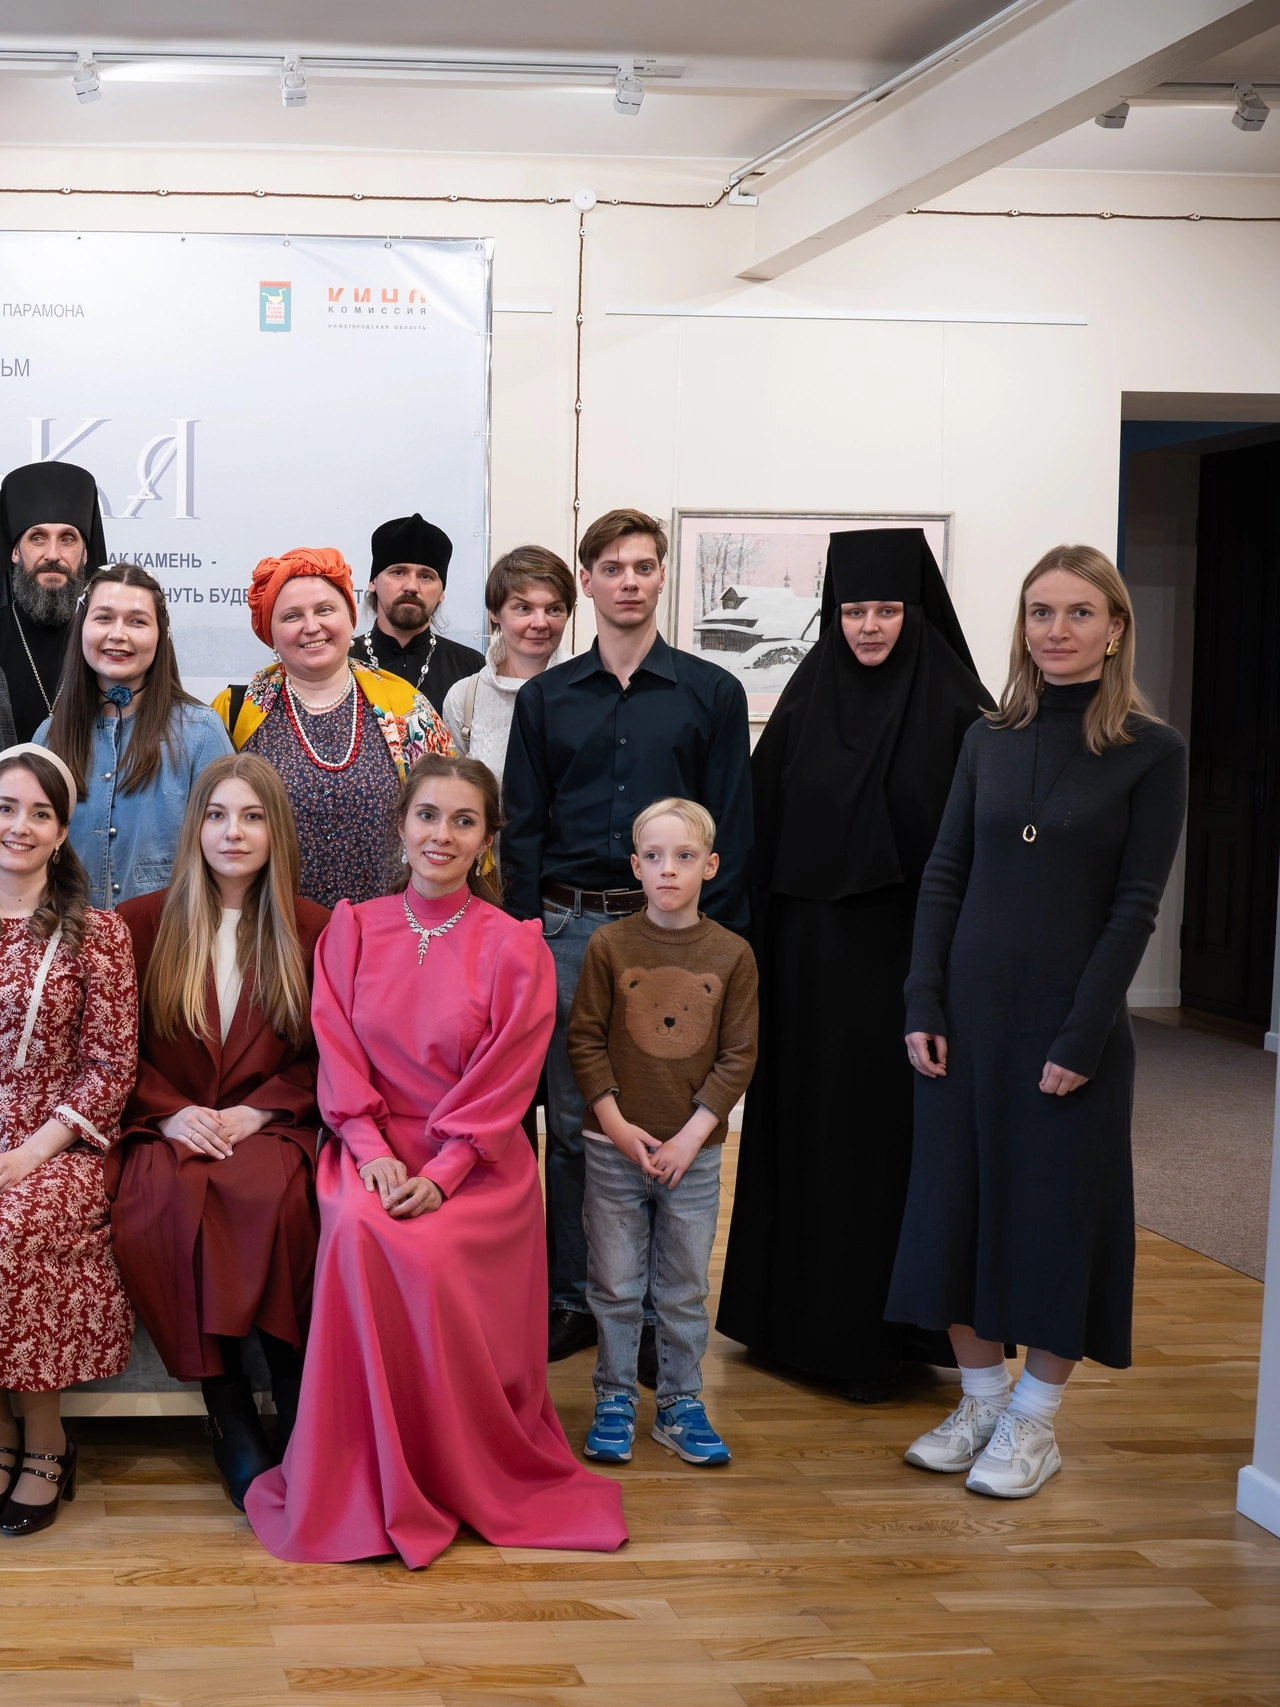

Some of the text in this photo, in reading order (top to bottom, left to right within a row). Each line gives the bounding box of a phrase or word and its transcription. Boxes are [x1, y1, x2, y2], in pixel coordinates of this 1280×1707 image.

[2, 303, 85, 318] ПАРАМОНА
[328, 306, 427, 315] КОМИССИЯ
[107, 552, 128, 565] АК
[134, 553, 202, 568] КАМЕНЬ
[162, 588, 250, 606] НУТЬ БУДЕ
